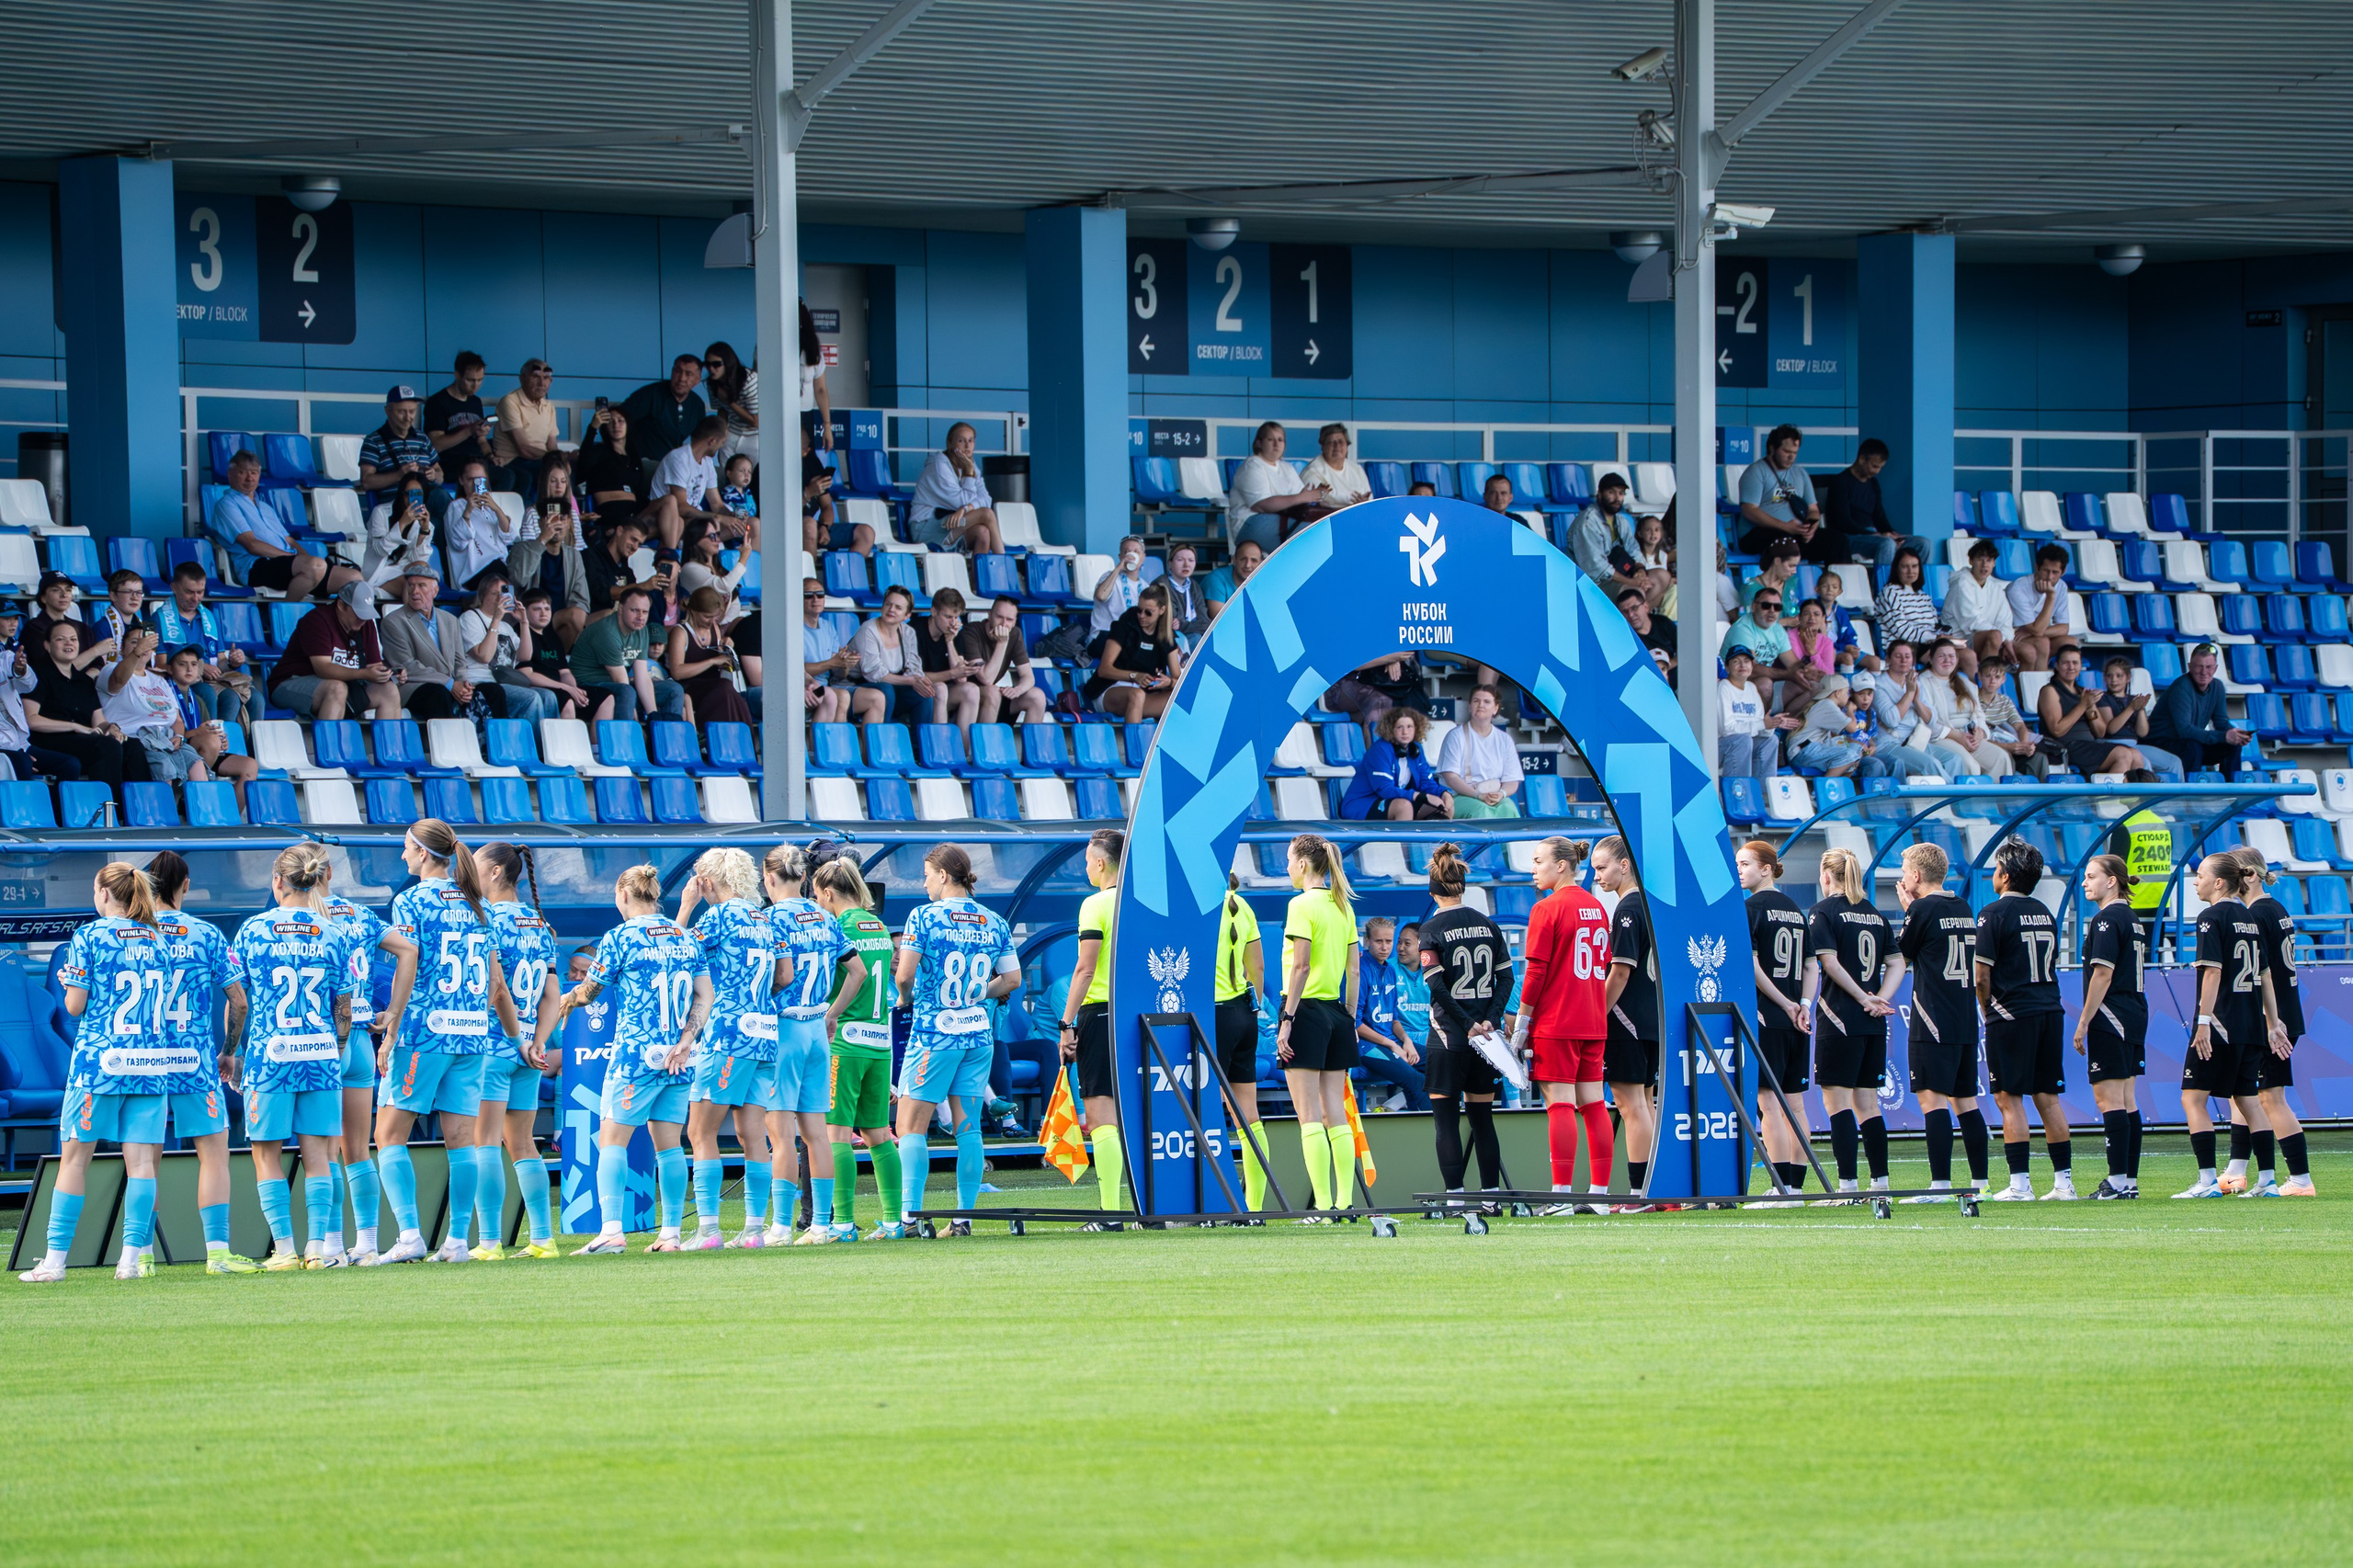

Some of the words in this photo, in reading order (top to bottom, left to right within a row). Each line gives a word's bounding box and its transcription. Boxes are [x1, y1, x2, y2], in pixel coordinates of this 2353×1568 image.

[189, 207, 223, 292] 3
[291, 212, 319, 284] 2
[1134, 253, 1157, 320] 3
[1215, 255, 1243, 332] 2
[1300, 260, 1318, 323] 1
[216, 306, 248, 323] BLOCK
[1794, 274, 1813, 346] 1
[1197, 345, 1228, 359] СЕКТОР
[1235, 347, 1263, 360] BLOCK
[1776, 358, 1806, 373] СЕКТОР
[1813, 360, 1837, 373] BLOCK
[867, 424, 878, 438] 10
[1132, 431, 1143, 446] 10
[1172, 432, 1191, 446] 15-2
[1740, 439, 1749, 453] 10
[1403, 602, 1447, 621] КУБОК
[1398, 626, 1453, 644] РОССИИ
[1521, 756, 1540, 770] 15-2
[2132, 845, 2171, 864] 2409
[3, 886, 26, 901] 29-1
[515, 918, 540, 926] WINLINE
[797, 913, 822, 922] WINLINE
[952, 914, 980, 923] WINLINE
[1578, 908, 1603, 921] СЕВКО
[1839, 911, 1884, 926] ТИХОВОДОВА
[2019, 915, 2052, 926] АСАДОВА
[119, 929, 151, 938] WINLINE
[276, 925, 311, 934] WINLINE
[649, 926, 676, 936] WINLINE
[859, 922, 881, 930] WINLINE
[1444, 926, 1494, 943] НУРГАЛИЕВА
[945, 928, 995, 945] ПОЗДЕЕВА
[271, 942, 324, 958] ХОХЛОВА
[644, 946, 695, 960] АНДРЕЕВА
[1574, 926, 1608, 981] 63
[1773, 926, 1804, 981] 91
[1858, 929, 1876, 982] 9
[2020, 930, 2056, 983] 17
[438, 931, 486, 995] 55
[1450, 944, 1494, 999] 22
[939, 950, 992, 1009] 88
[271, 965, 325, 1028] 23
[512, 959, 548, 1019] 99
[871, 960, 882, 1019] 1
[651, 970, 693, 1032] 10
